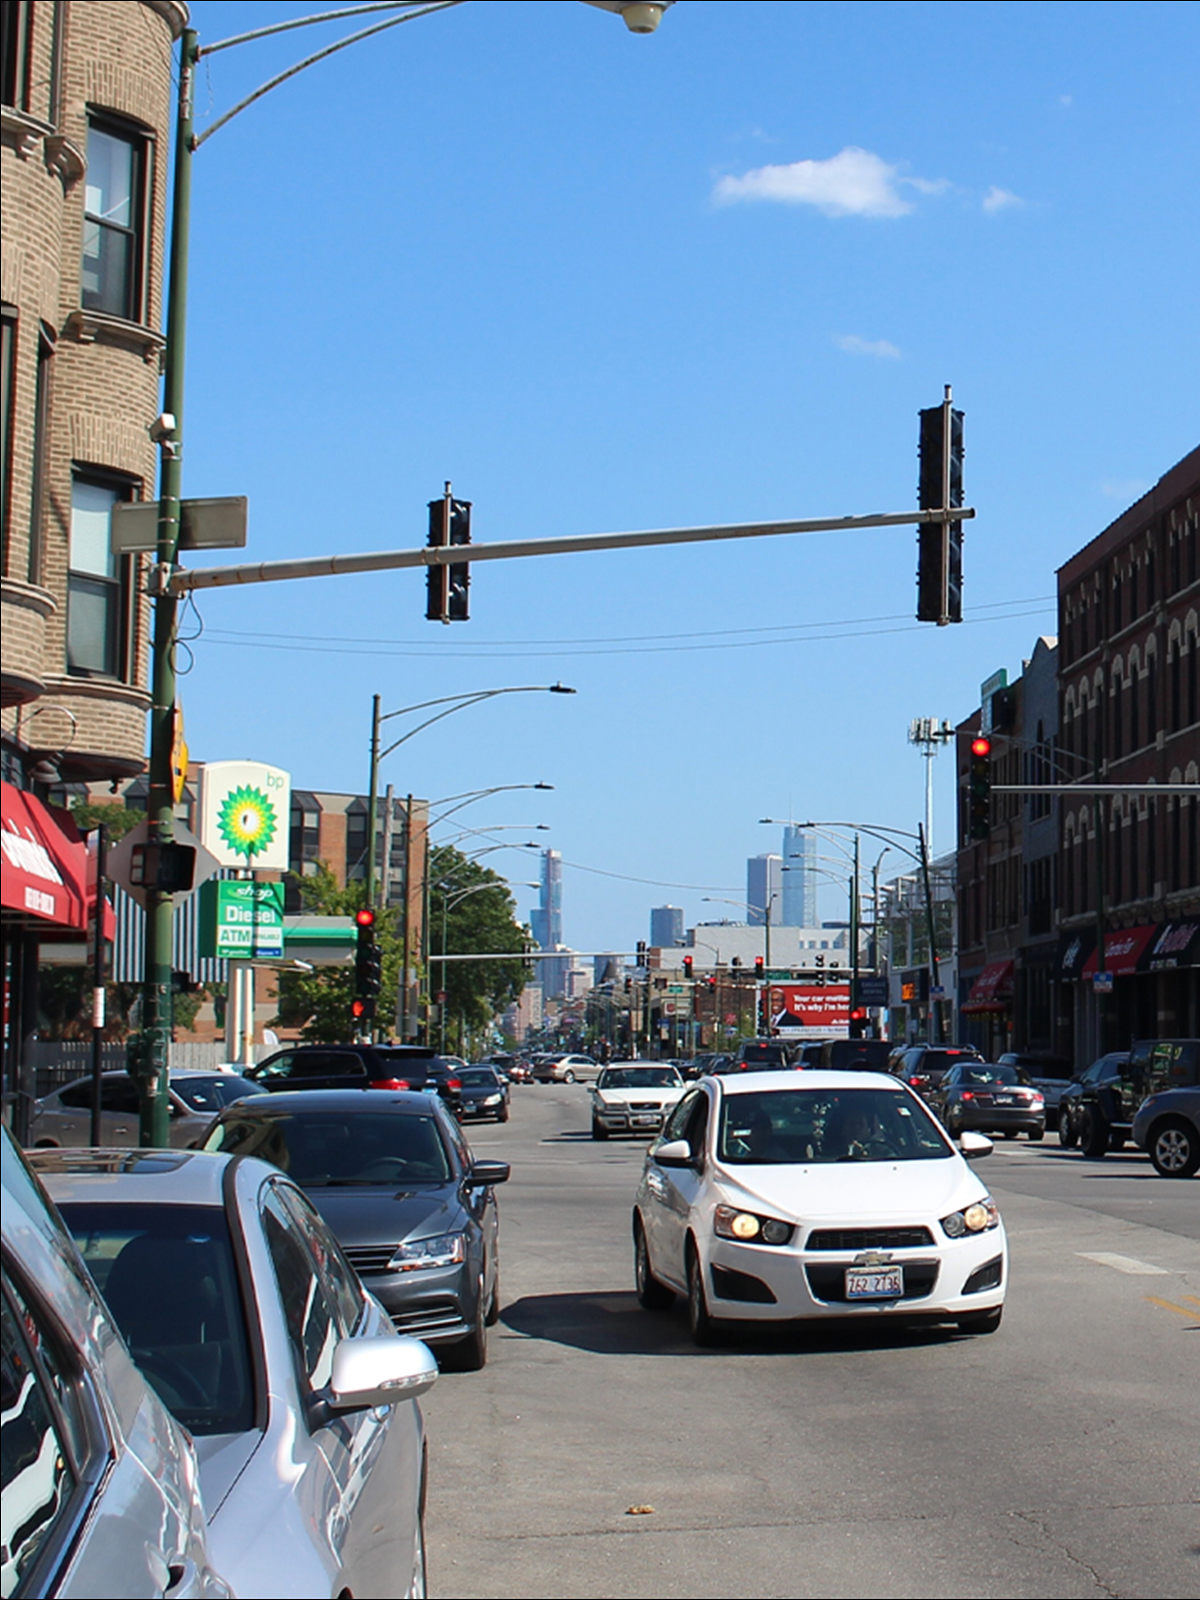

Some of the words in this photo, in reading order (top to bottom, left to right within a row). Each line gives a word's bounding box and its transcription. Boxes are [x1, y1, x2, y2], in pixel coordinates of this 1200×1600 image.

[266, 772, 285, 789] bp
[237, 885, 274, 901] shop
[226, 905, 276, 923] Diesel
[221, 929, 250, 942] ATM
